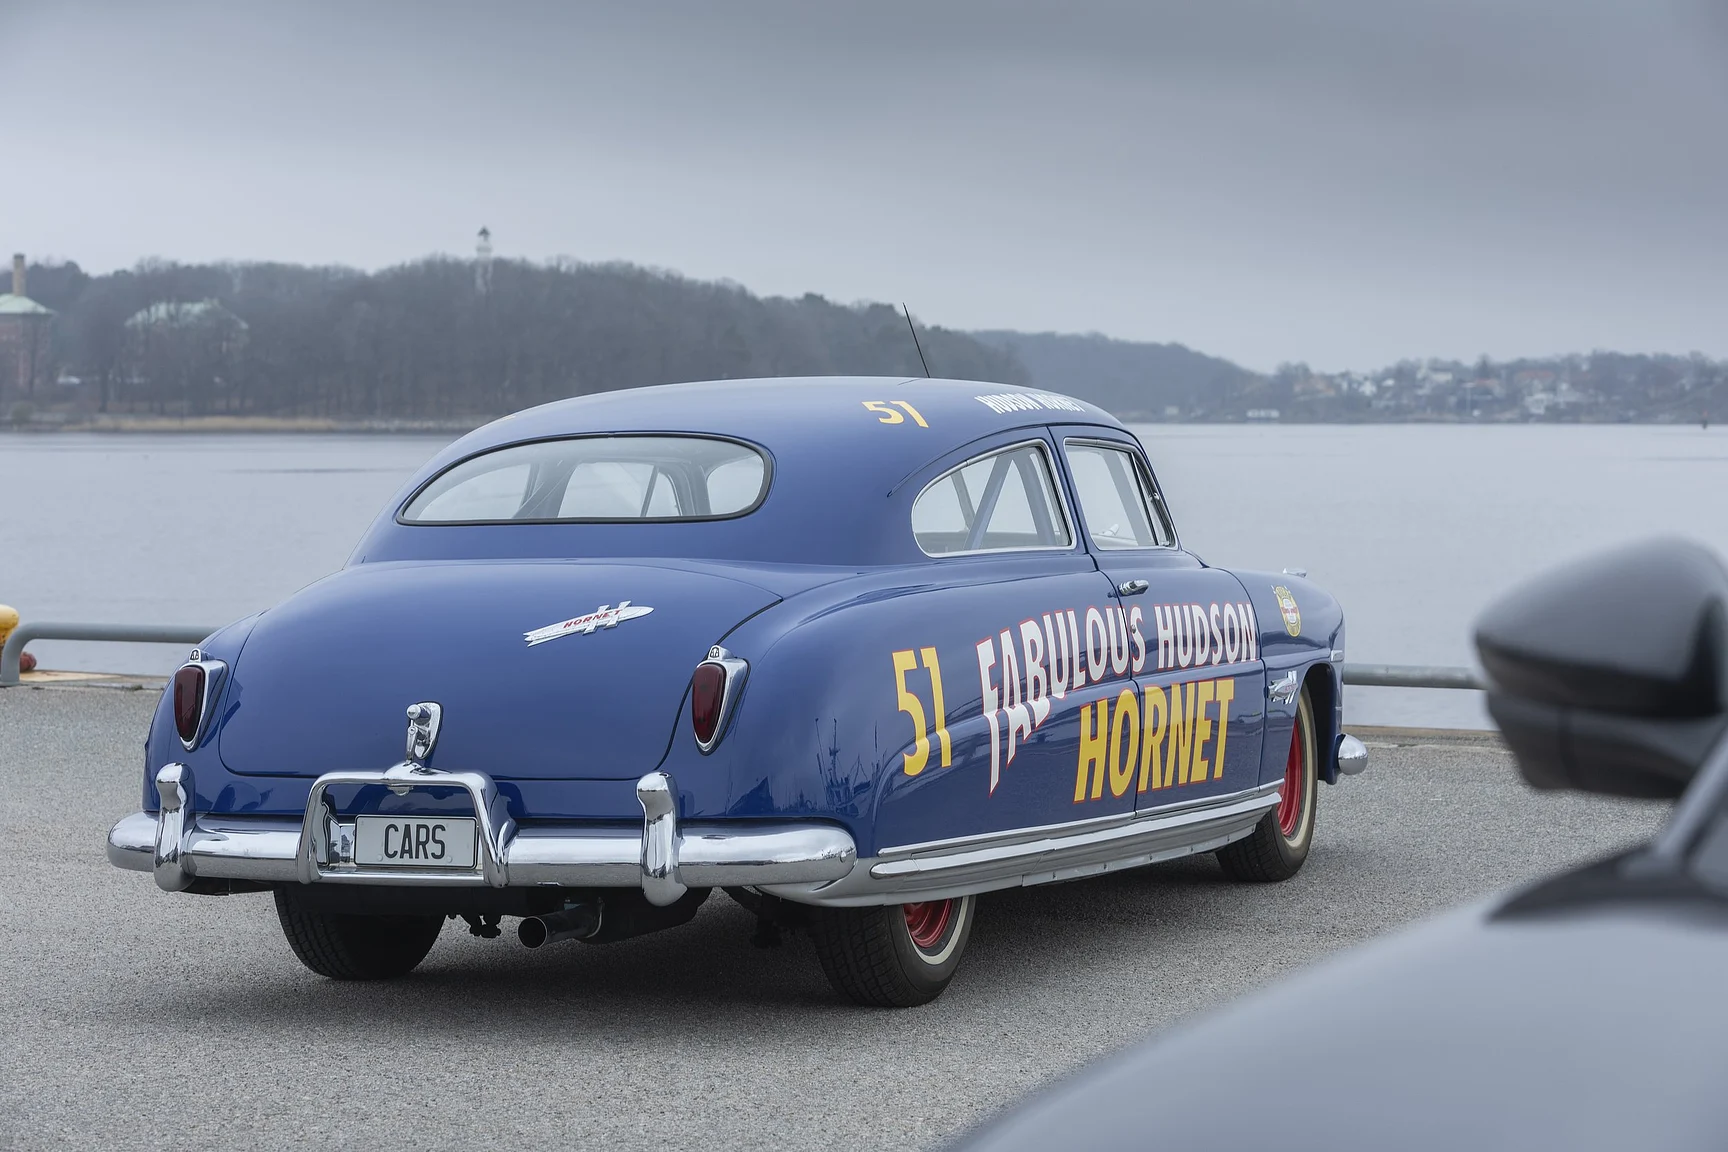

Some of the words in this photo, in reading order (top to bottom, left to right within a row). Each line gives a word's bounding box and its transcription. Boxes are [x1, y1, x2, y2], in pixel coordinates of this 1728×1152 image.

[862, 401, 929, 428] 51
[974, 393, 1043, 414] HUDSON
[563, 609, 621, 628] HORNET
[892, 646, 952, 777] 51
[976, 605, 1145, 796] FABULOUS
[1153, 602, 1258, 669] HUDSON
[1073, 677, 1235, 804] HORNET
[384, 823, 446, 860] CARS
